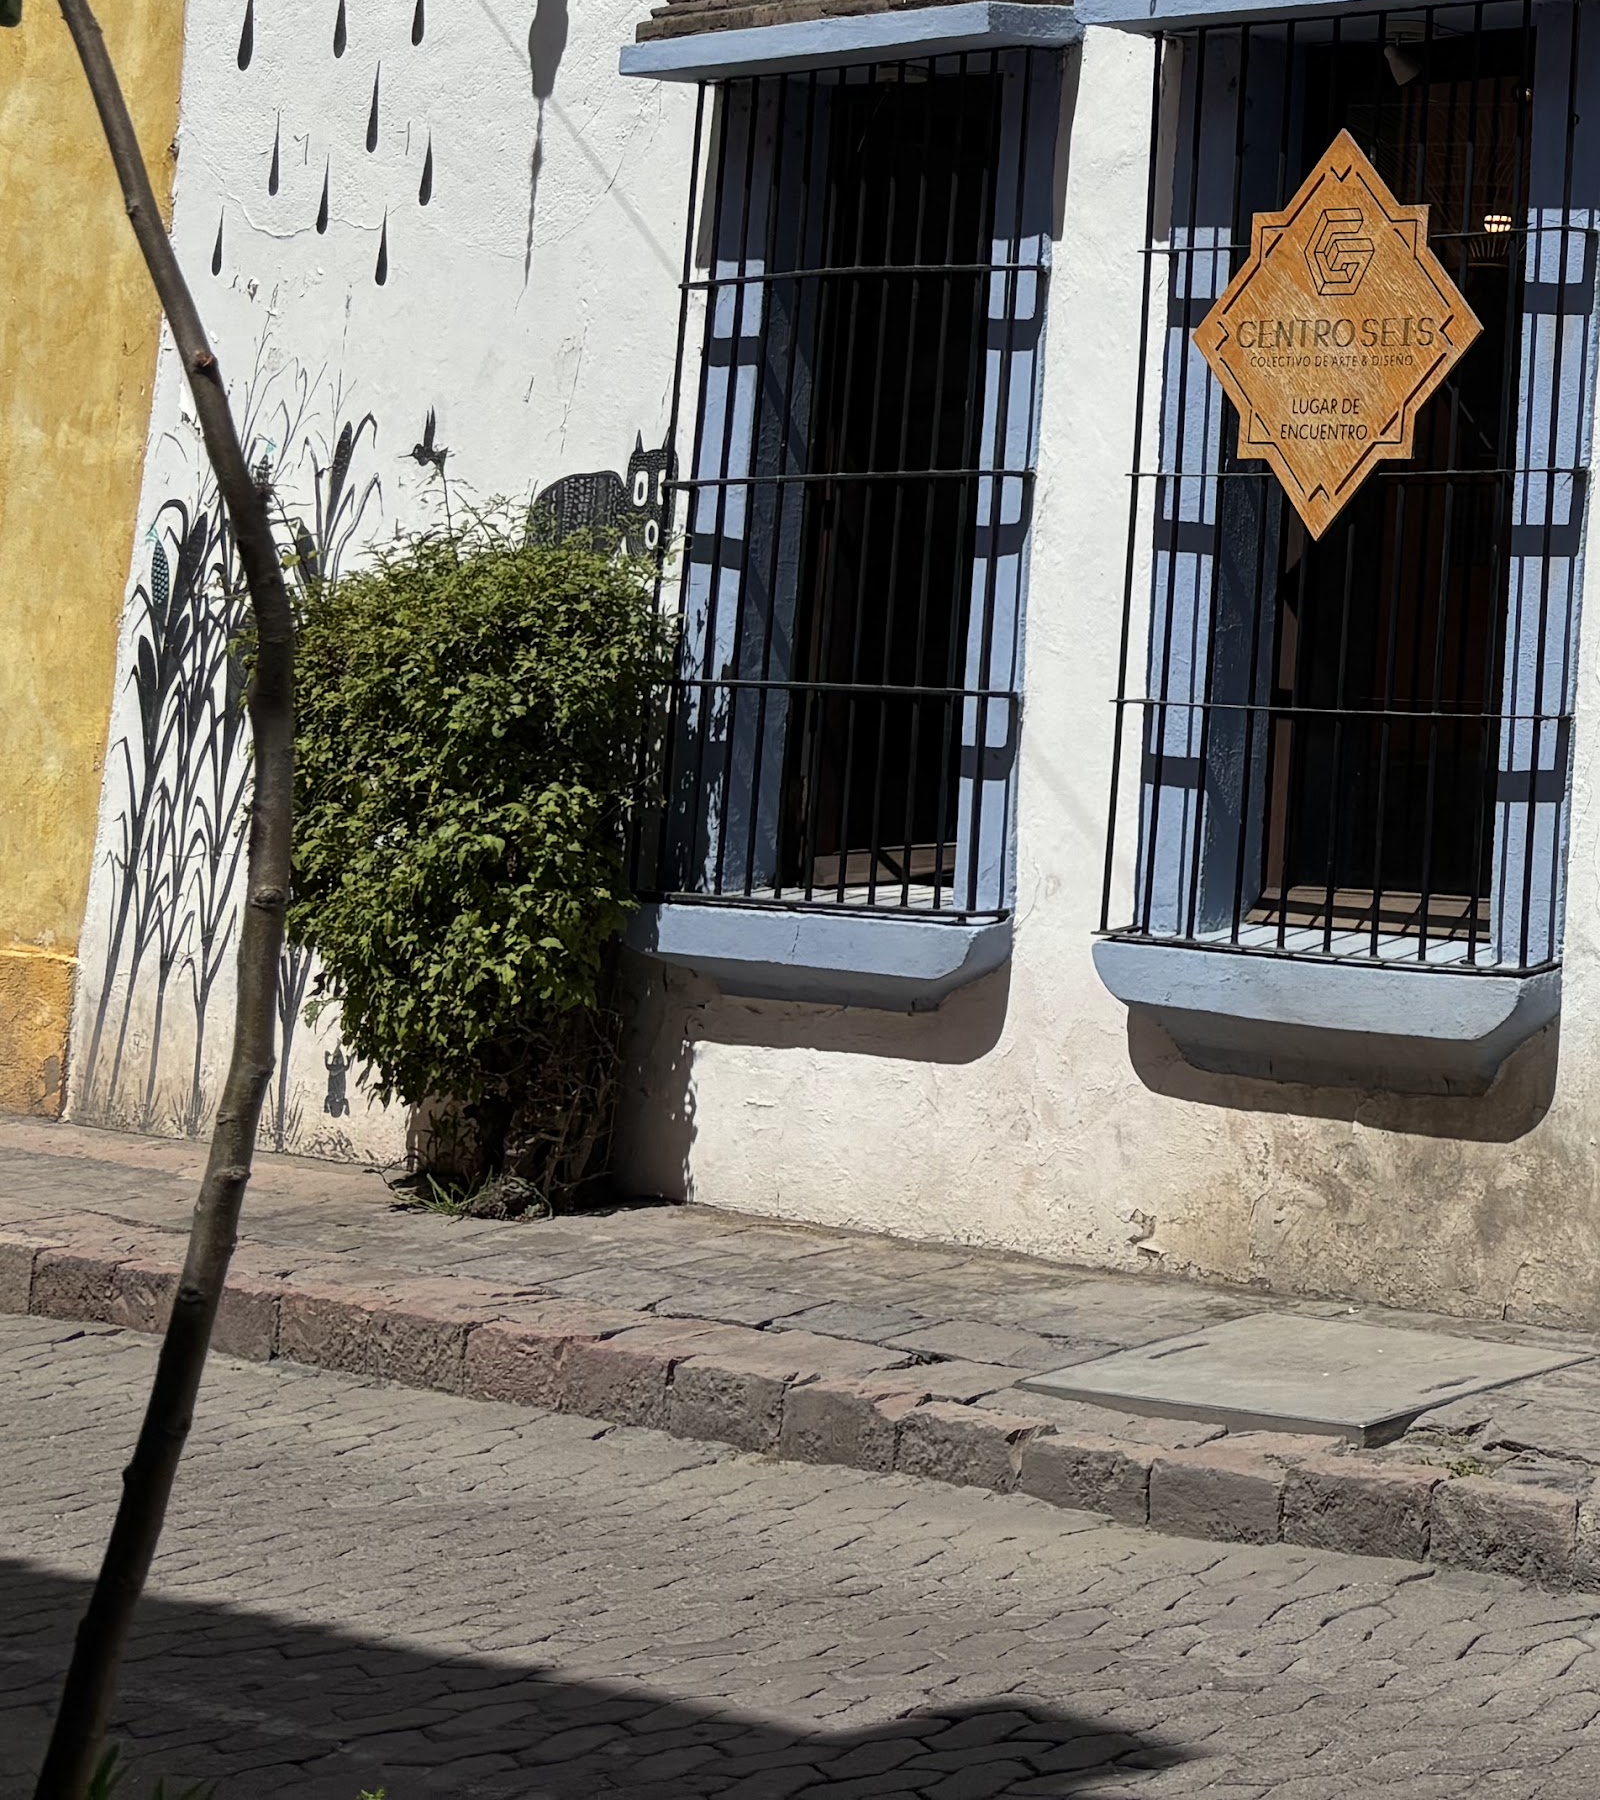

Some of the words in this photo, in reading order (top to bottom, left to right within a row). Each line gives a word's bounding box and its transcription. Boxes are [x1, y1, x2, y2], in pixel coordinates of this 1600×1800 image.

[1236, 317, 1356, 349] CENTRO
[1361, 317, 1435, 347] SEIS
[1250, 355, 1311, 368] COLECTIVO
[1315, 355, 1329, 367] DE
[1332, 355, 1358, 367] ARTE
[1372, 353, 1413, 366] DISEÑO
[1292, 398, 1338, 415] LUGAR
[1341, 398, 1360, 415] DE
[1280, 424, 1368, 440] ENCUENTRO
